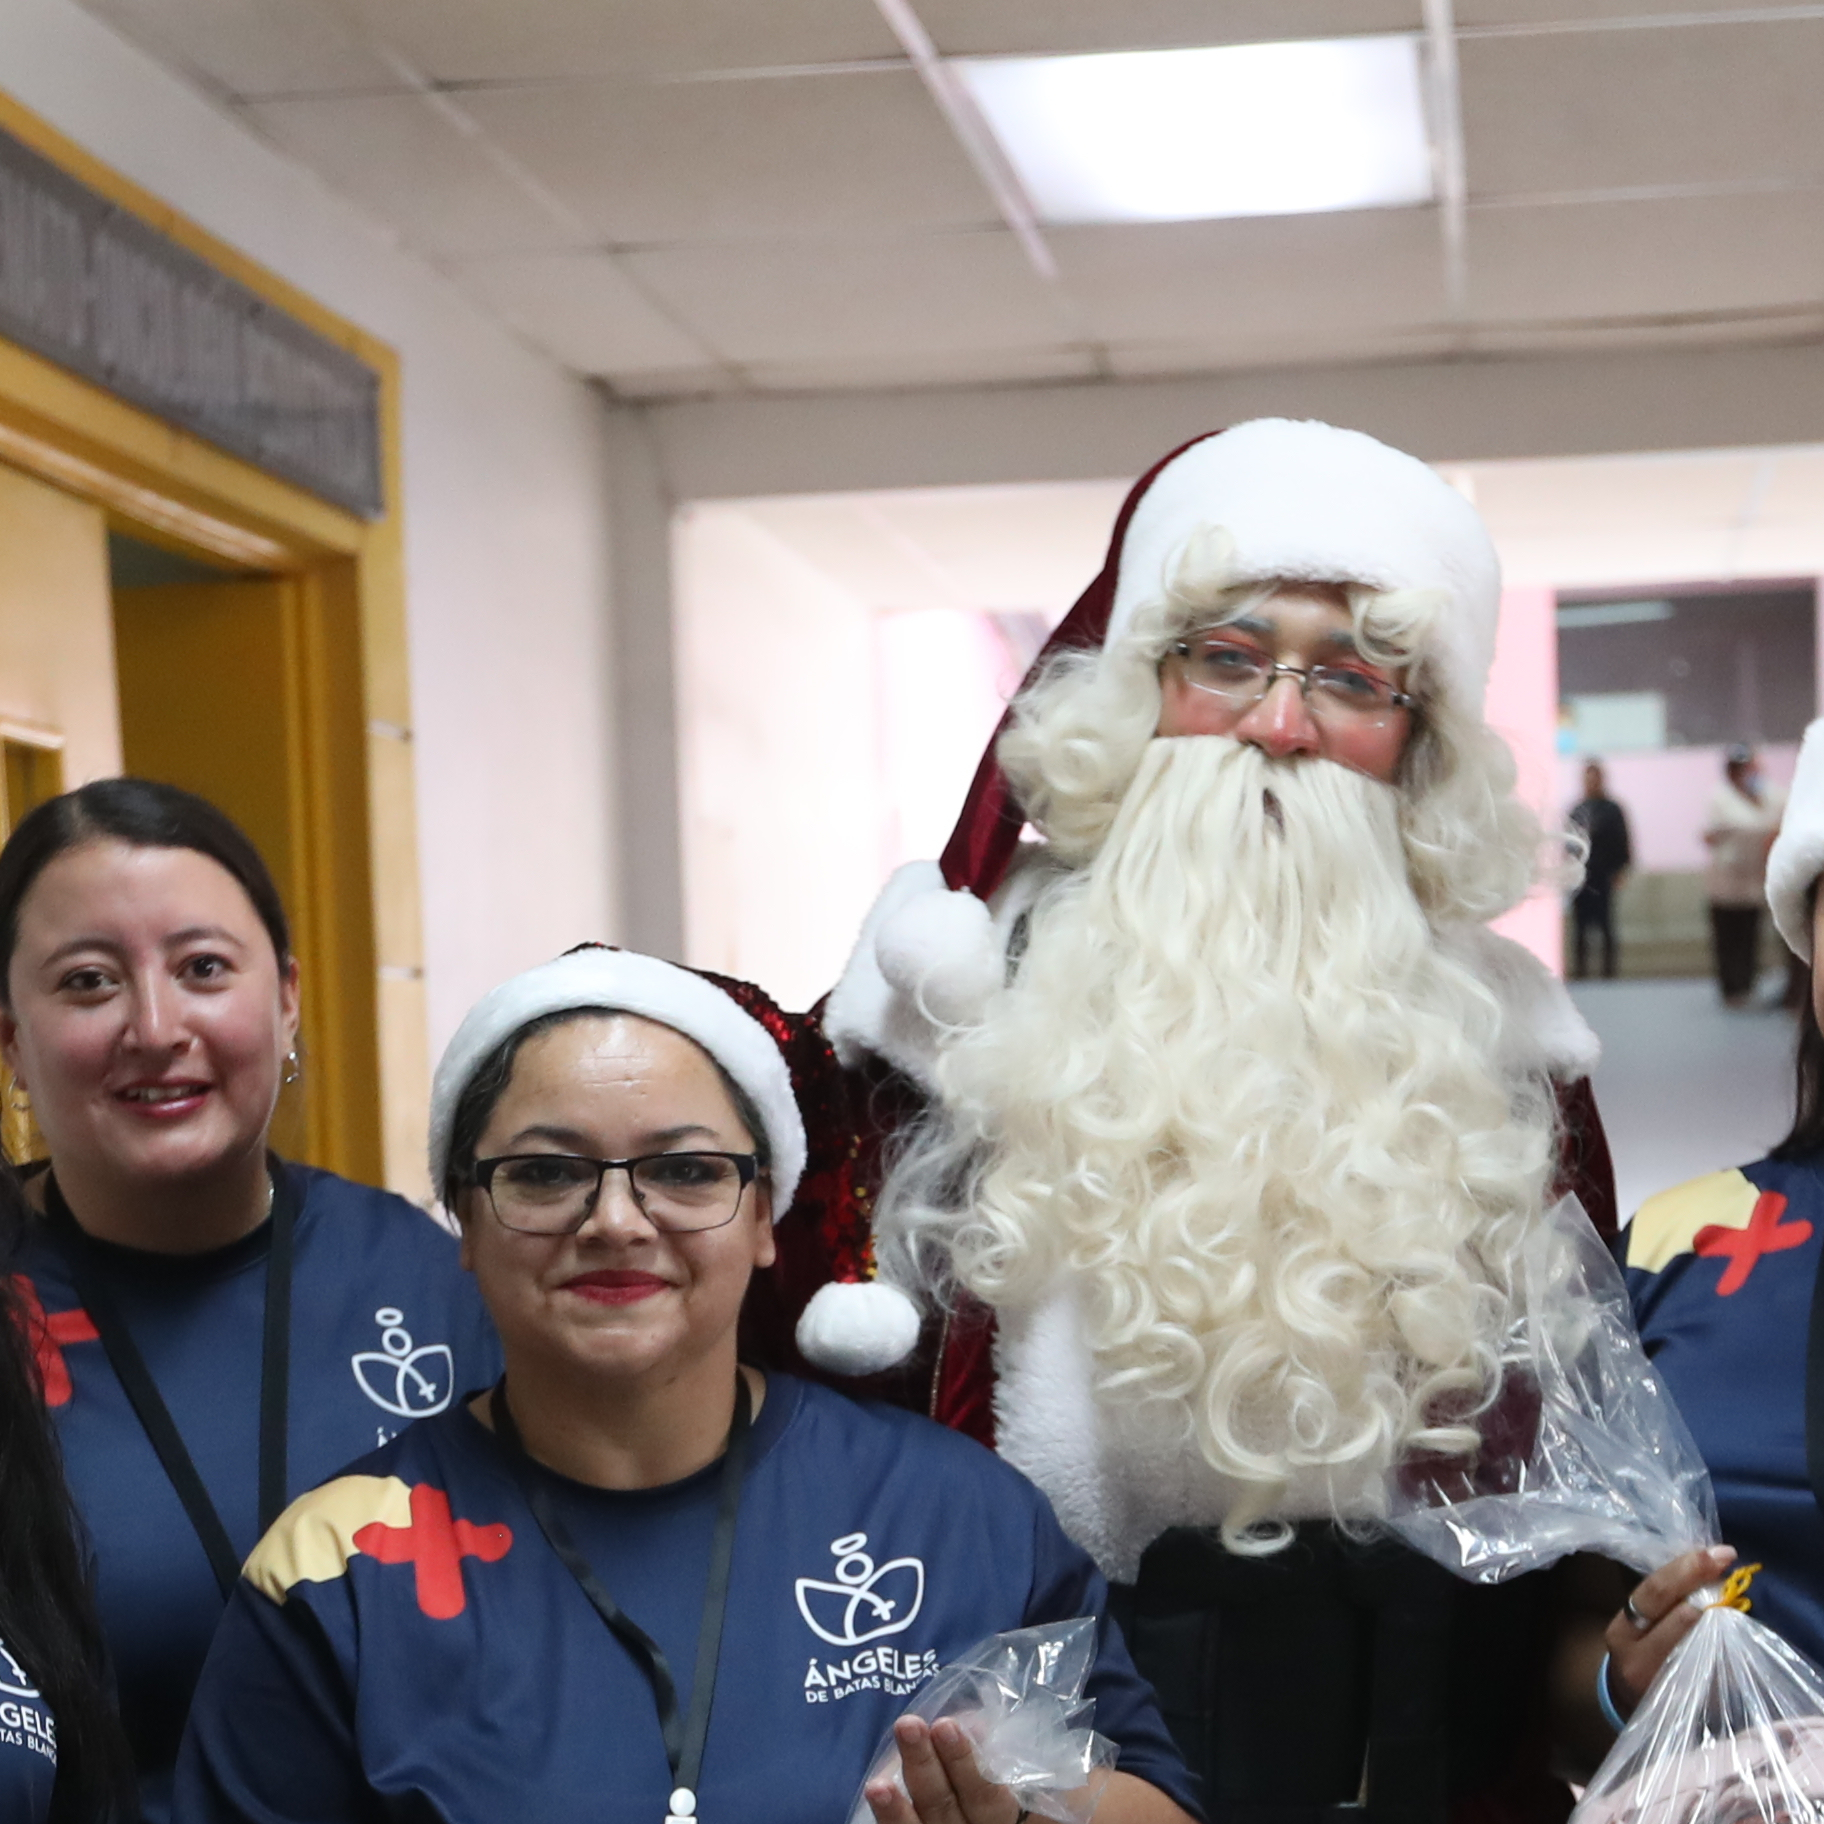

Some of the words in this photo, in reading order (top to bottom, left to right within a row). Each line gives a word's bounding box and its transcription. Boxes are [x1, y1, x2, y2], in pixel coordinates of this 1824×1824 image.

[804, 1646, 936, 1688] ÁNGELES
[805, 1690, 829, 1703] DE
[833, 1675, 881, 1700] BATAS
[883, 1663, 941, 1696] BLANAS
